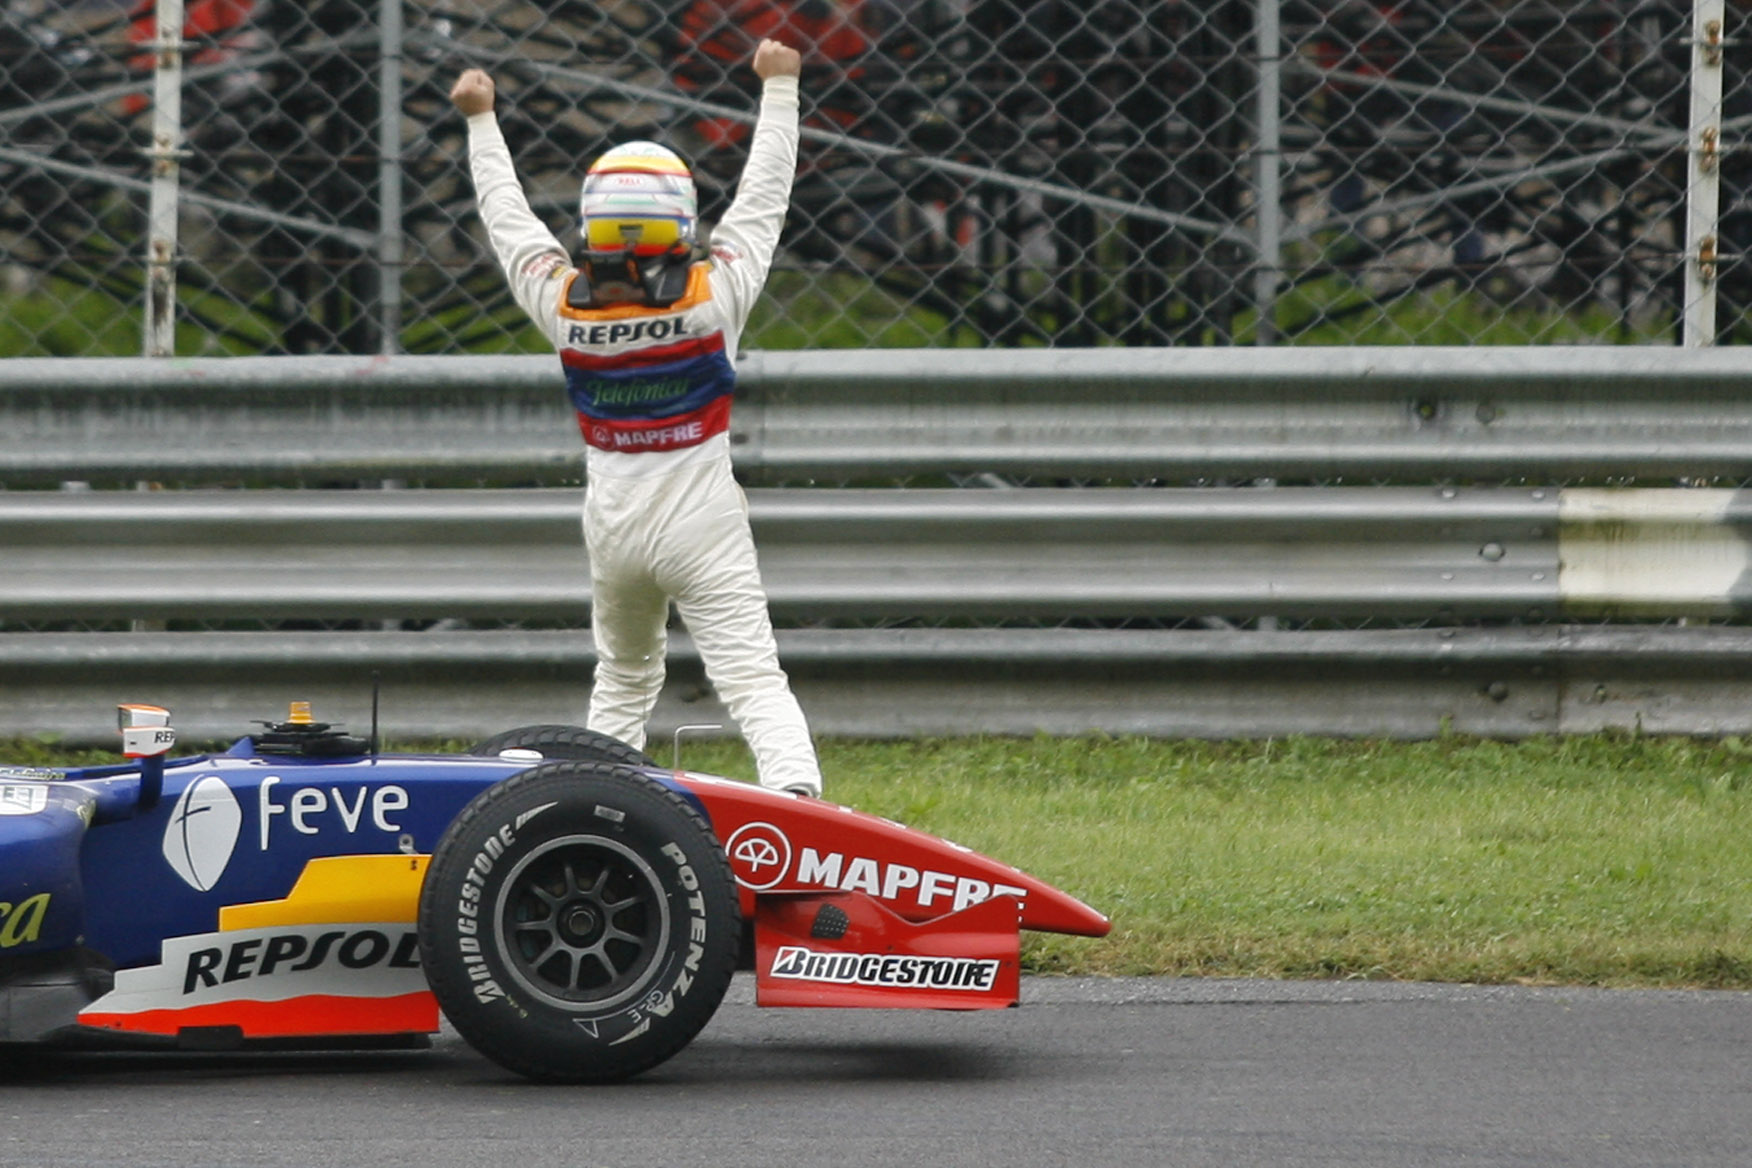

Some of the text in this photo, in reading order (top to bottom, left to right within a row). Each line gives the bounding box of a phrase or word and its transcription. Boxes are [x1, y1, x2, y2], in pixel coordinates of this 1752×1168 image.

[568, 318, 688, 344] REPSOL
[614, 422, 703, 446] MAPFRE
[259, 775, 409, 851] feve
[457, 823, 516, 1004] BRIDGESTONE
[653, 841, 707, 1017] POTENZA
[183, 930, 423, 995] REPSOL
[772, 948, 994, 987] BRIDGESTONE
